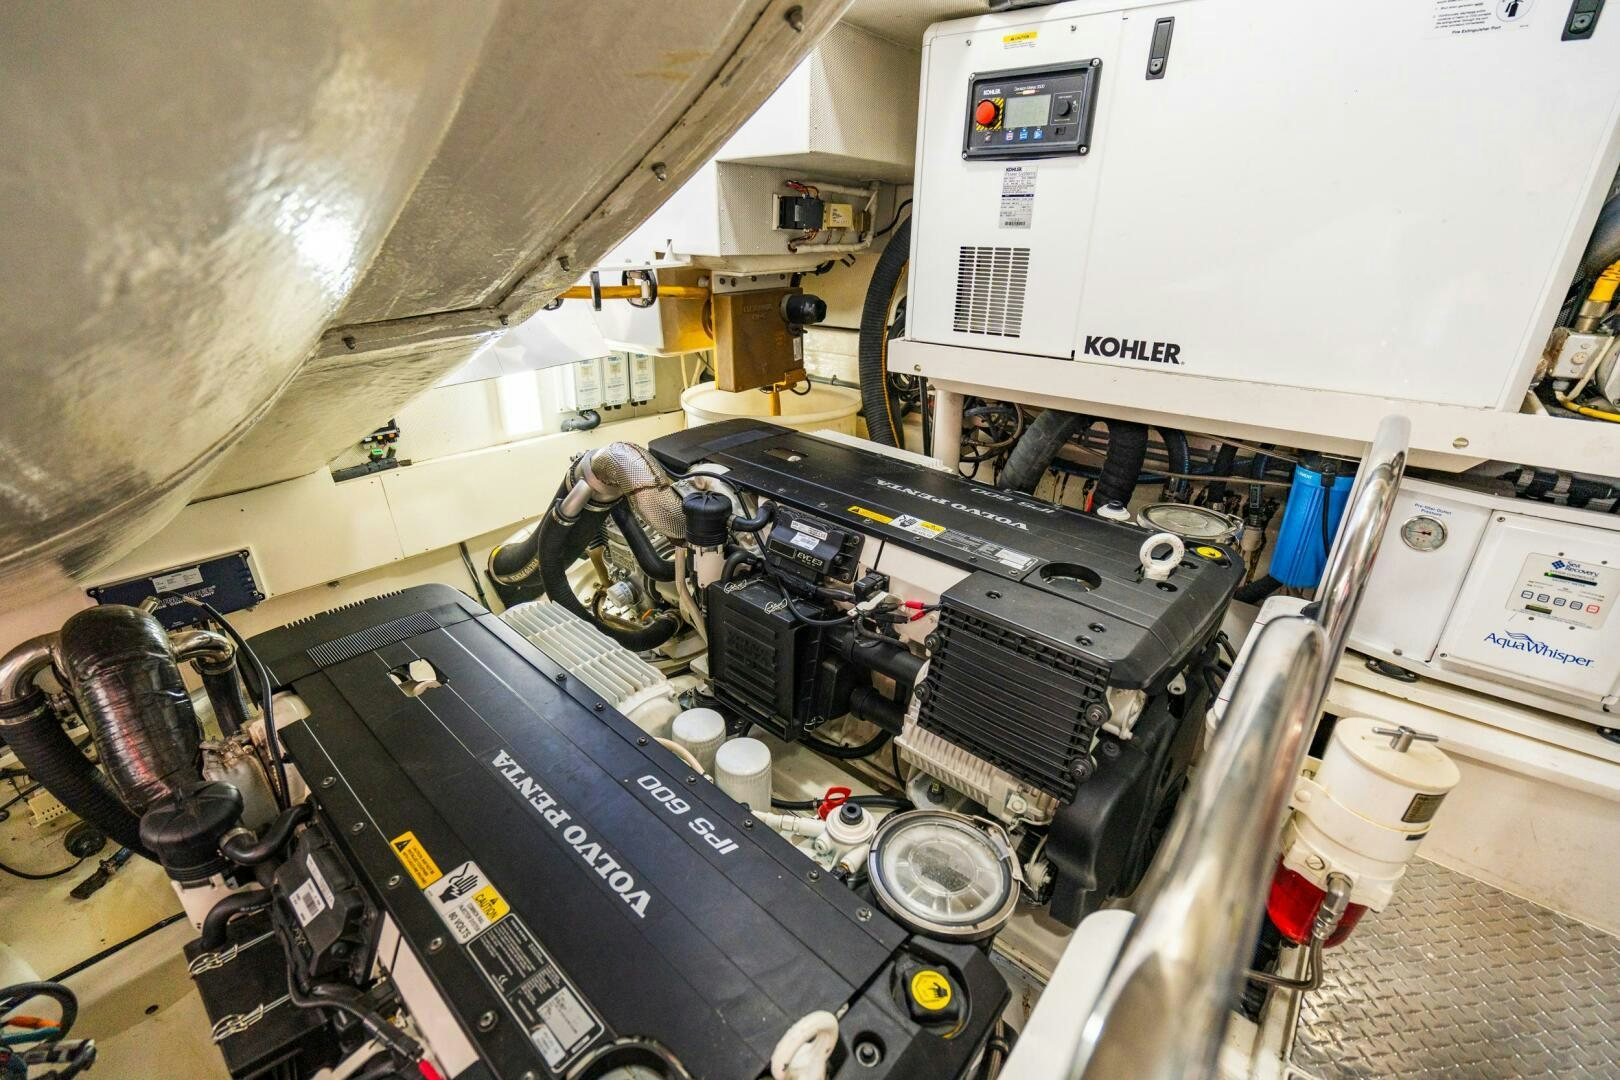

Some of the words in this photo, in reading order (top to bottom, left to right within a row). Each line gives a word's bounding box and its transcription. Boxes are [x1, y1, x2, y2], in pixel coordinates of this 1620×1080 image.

[1084, 335, 1181, 365] KOHLER
[876, 478, 951, 505] PENTA
[970, 487, 1014, 502] 600
[951, 503, 1031, 531] VOLVO
[1017, 501, 1056, 514] IPS
[1484, 632, 1594, 667] AquaWhisper
[492, 749, 572, 829] PENTA
[637, 775, 691, 815] 600
[688, 817, 740, 855] IPS
[563, 825, 651, 919] VOLVO
[474, 893, 498, 919] CAUTION
[452, 918, 471, 938] VOLTS
